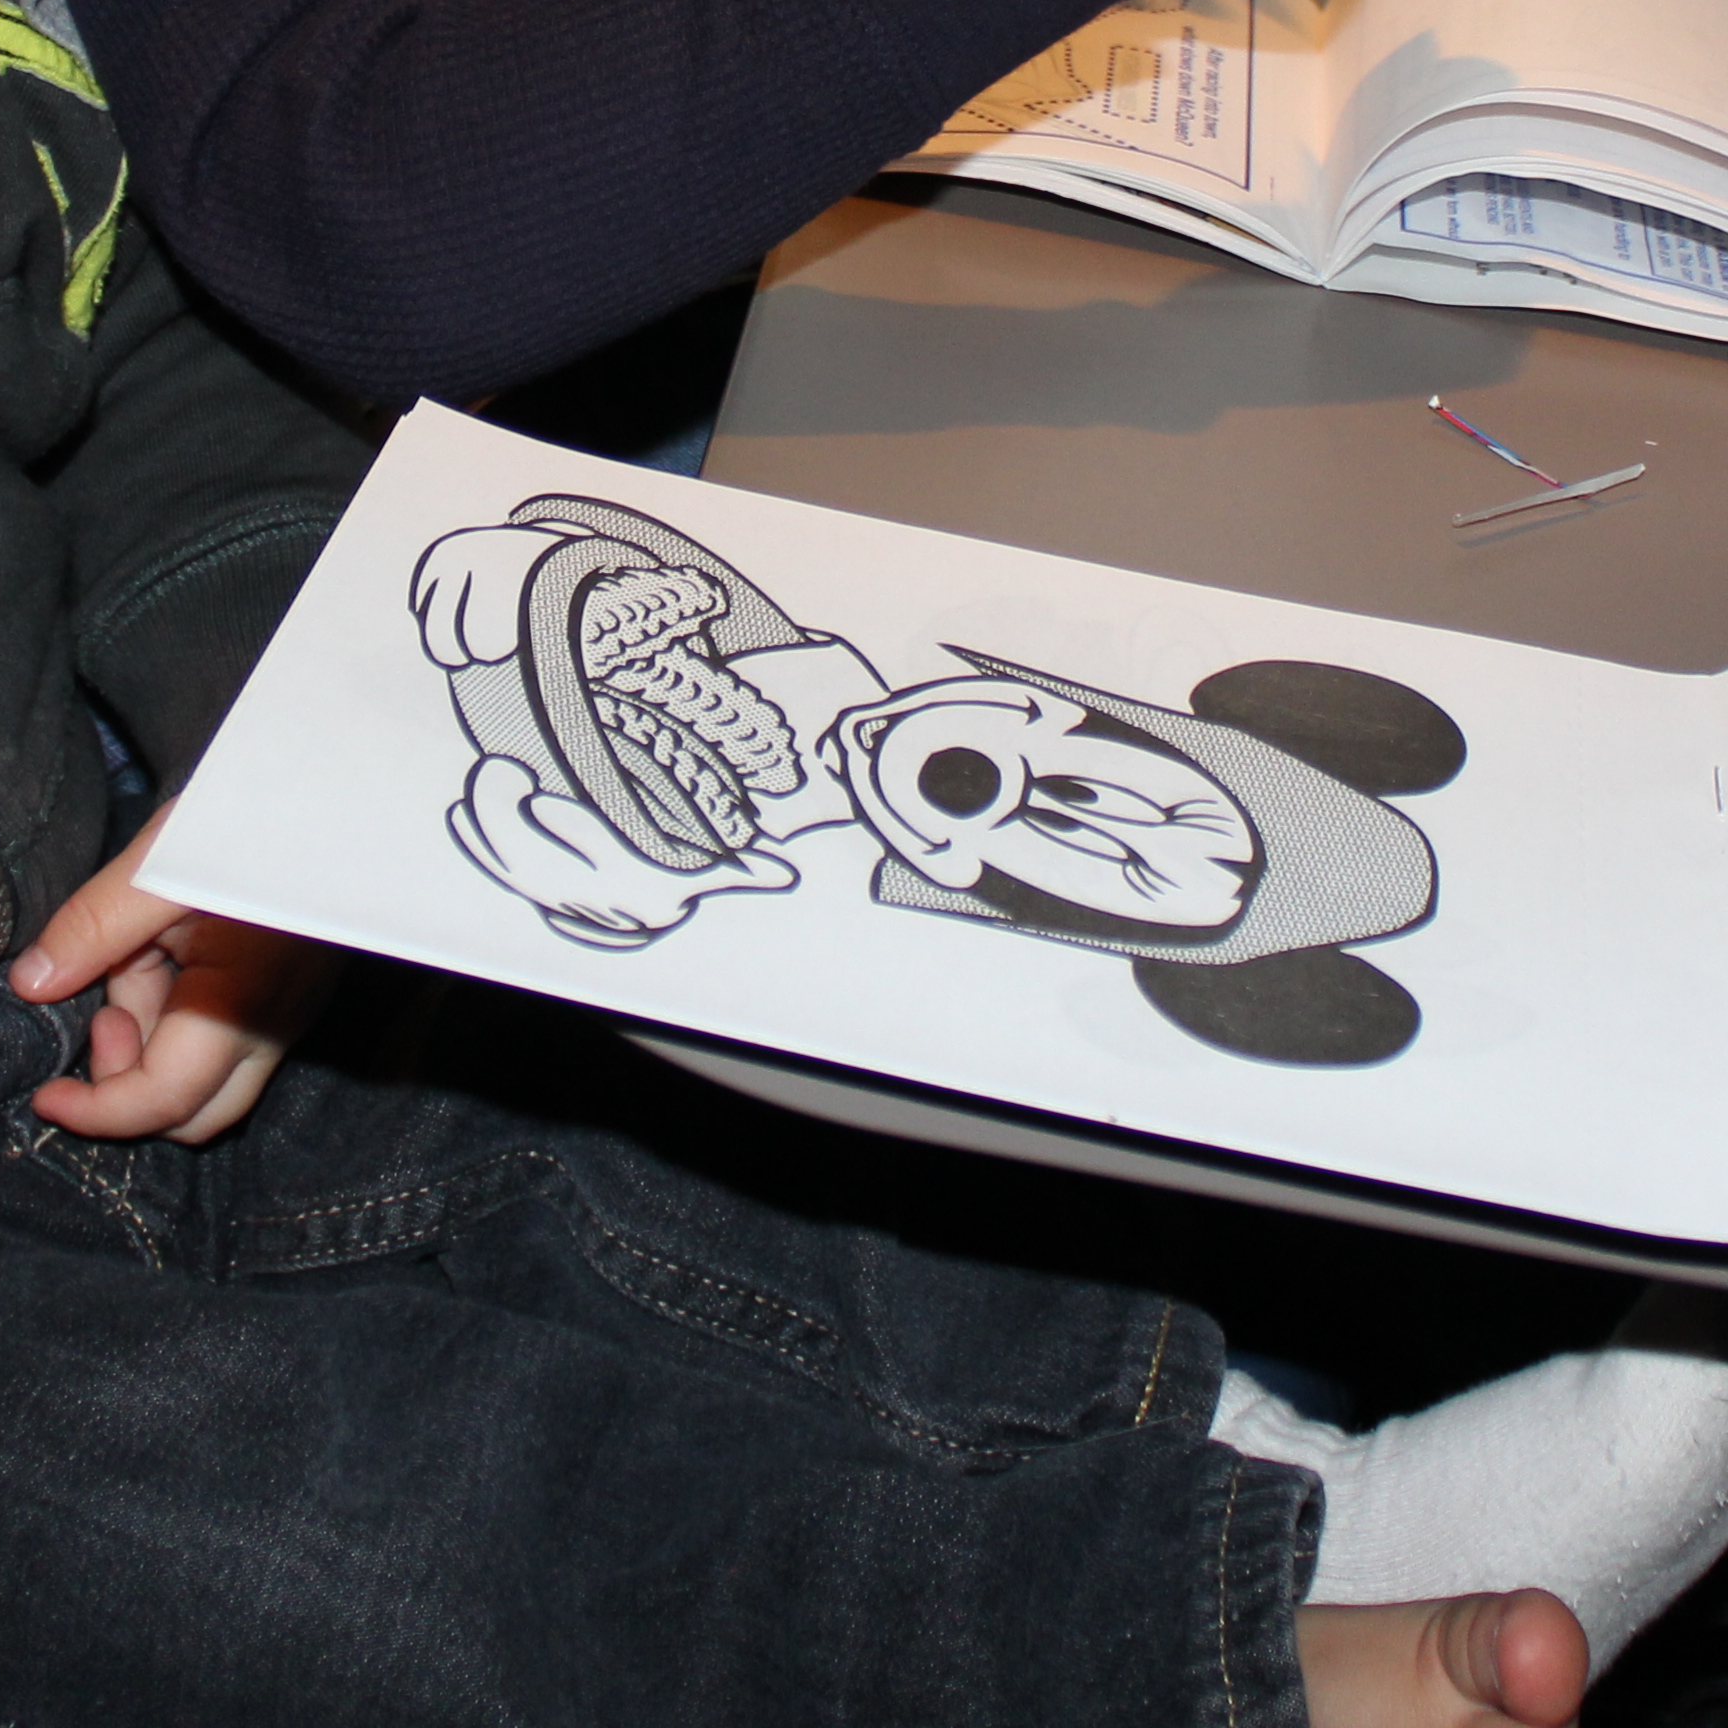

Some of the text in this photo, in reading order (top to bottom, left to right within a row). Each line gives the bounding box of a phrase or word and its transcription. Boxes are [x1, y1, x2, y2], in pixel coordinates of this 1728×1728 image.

[1179, 48, 1195, 72] slows
[1208, 48, 1223, 68] After
[1178, 72, 1194, 96] down
[1200, 69, 1223, 96] racing
[1204, 97, 1221, 115] into
[1174, 97, 1196, 147] McQueen?
